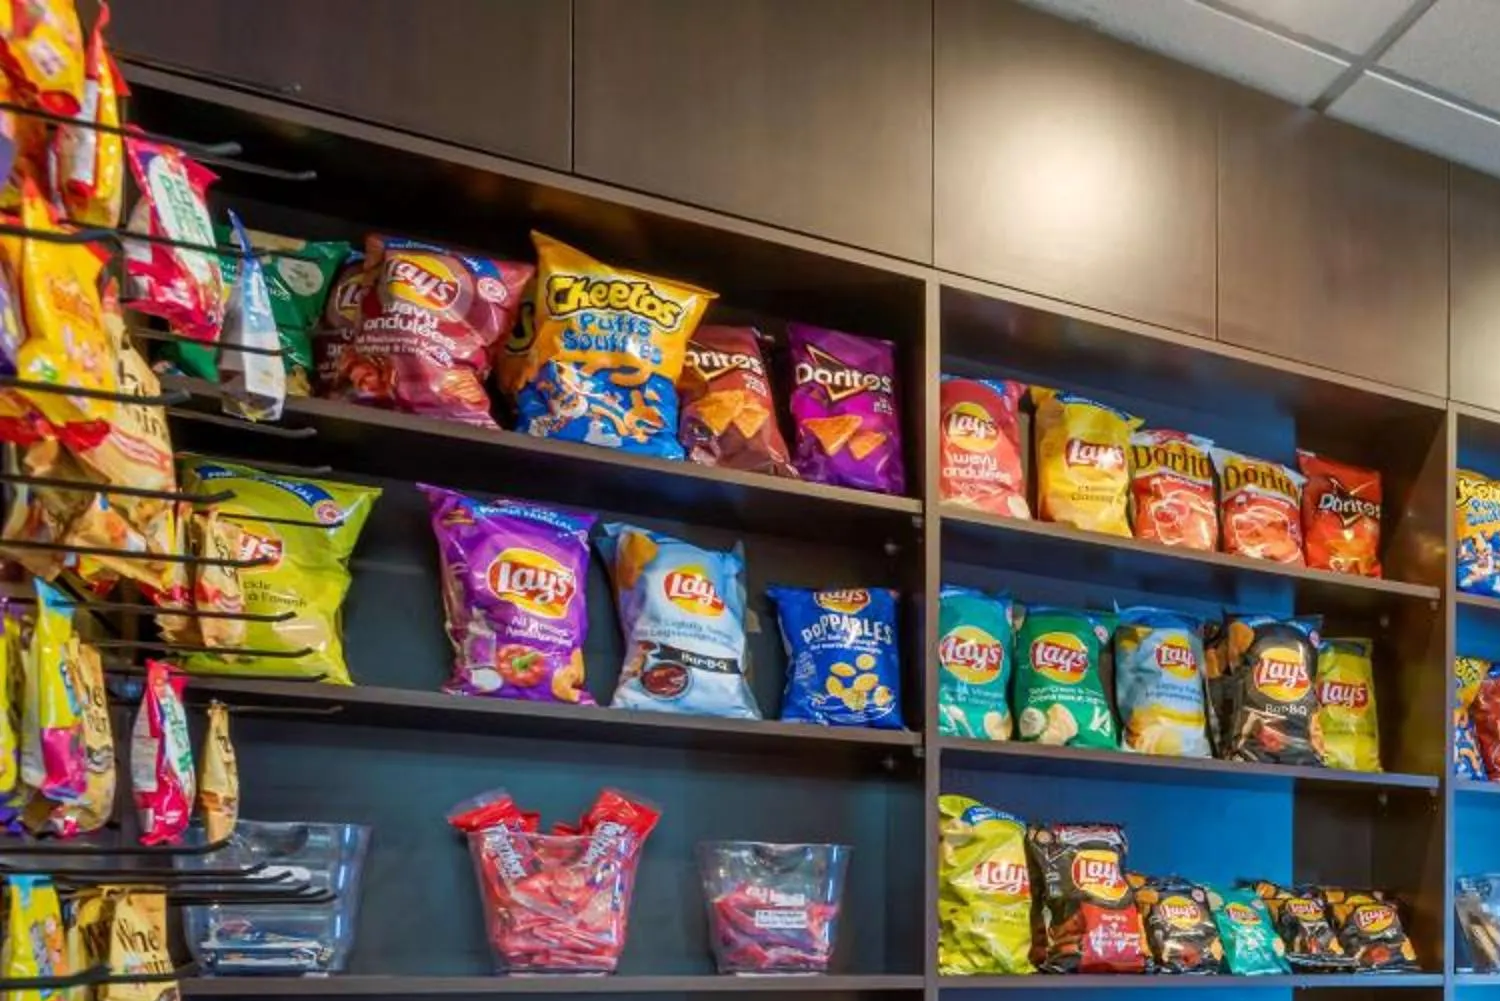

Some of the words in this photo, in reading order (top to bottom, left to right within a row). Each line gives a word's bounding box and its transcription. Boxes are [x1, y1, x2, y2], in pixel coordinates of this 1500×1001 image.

[549, 275, 683, 329] Cheetos
[579, 311, 652, 339] Puffs
[684, 348, 765, 376] oritos
[796, 361, 893, 395] Doritos
[1134, 443, 1211, 478] Dorito
[1224, 463, 1298, 498] Dorito
[670, 571, 716, 604] Lay
